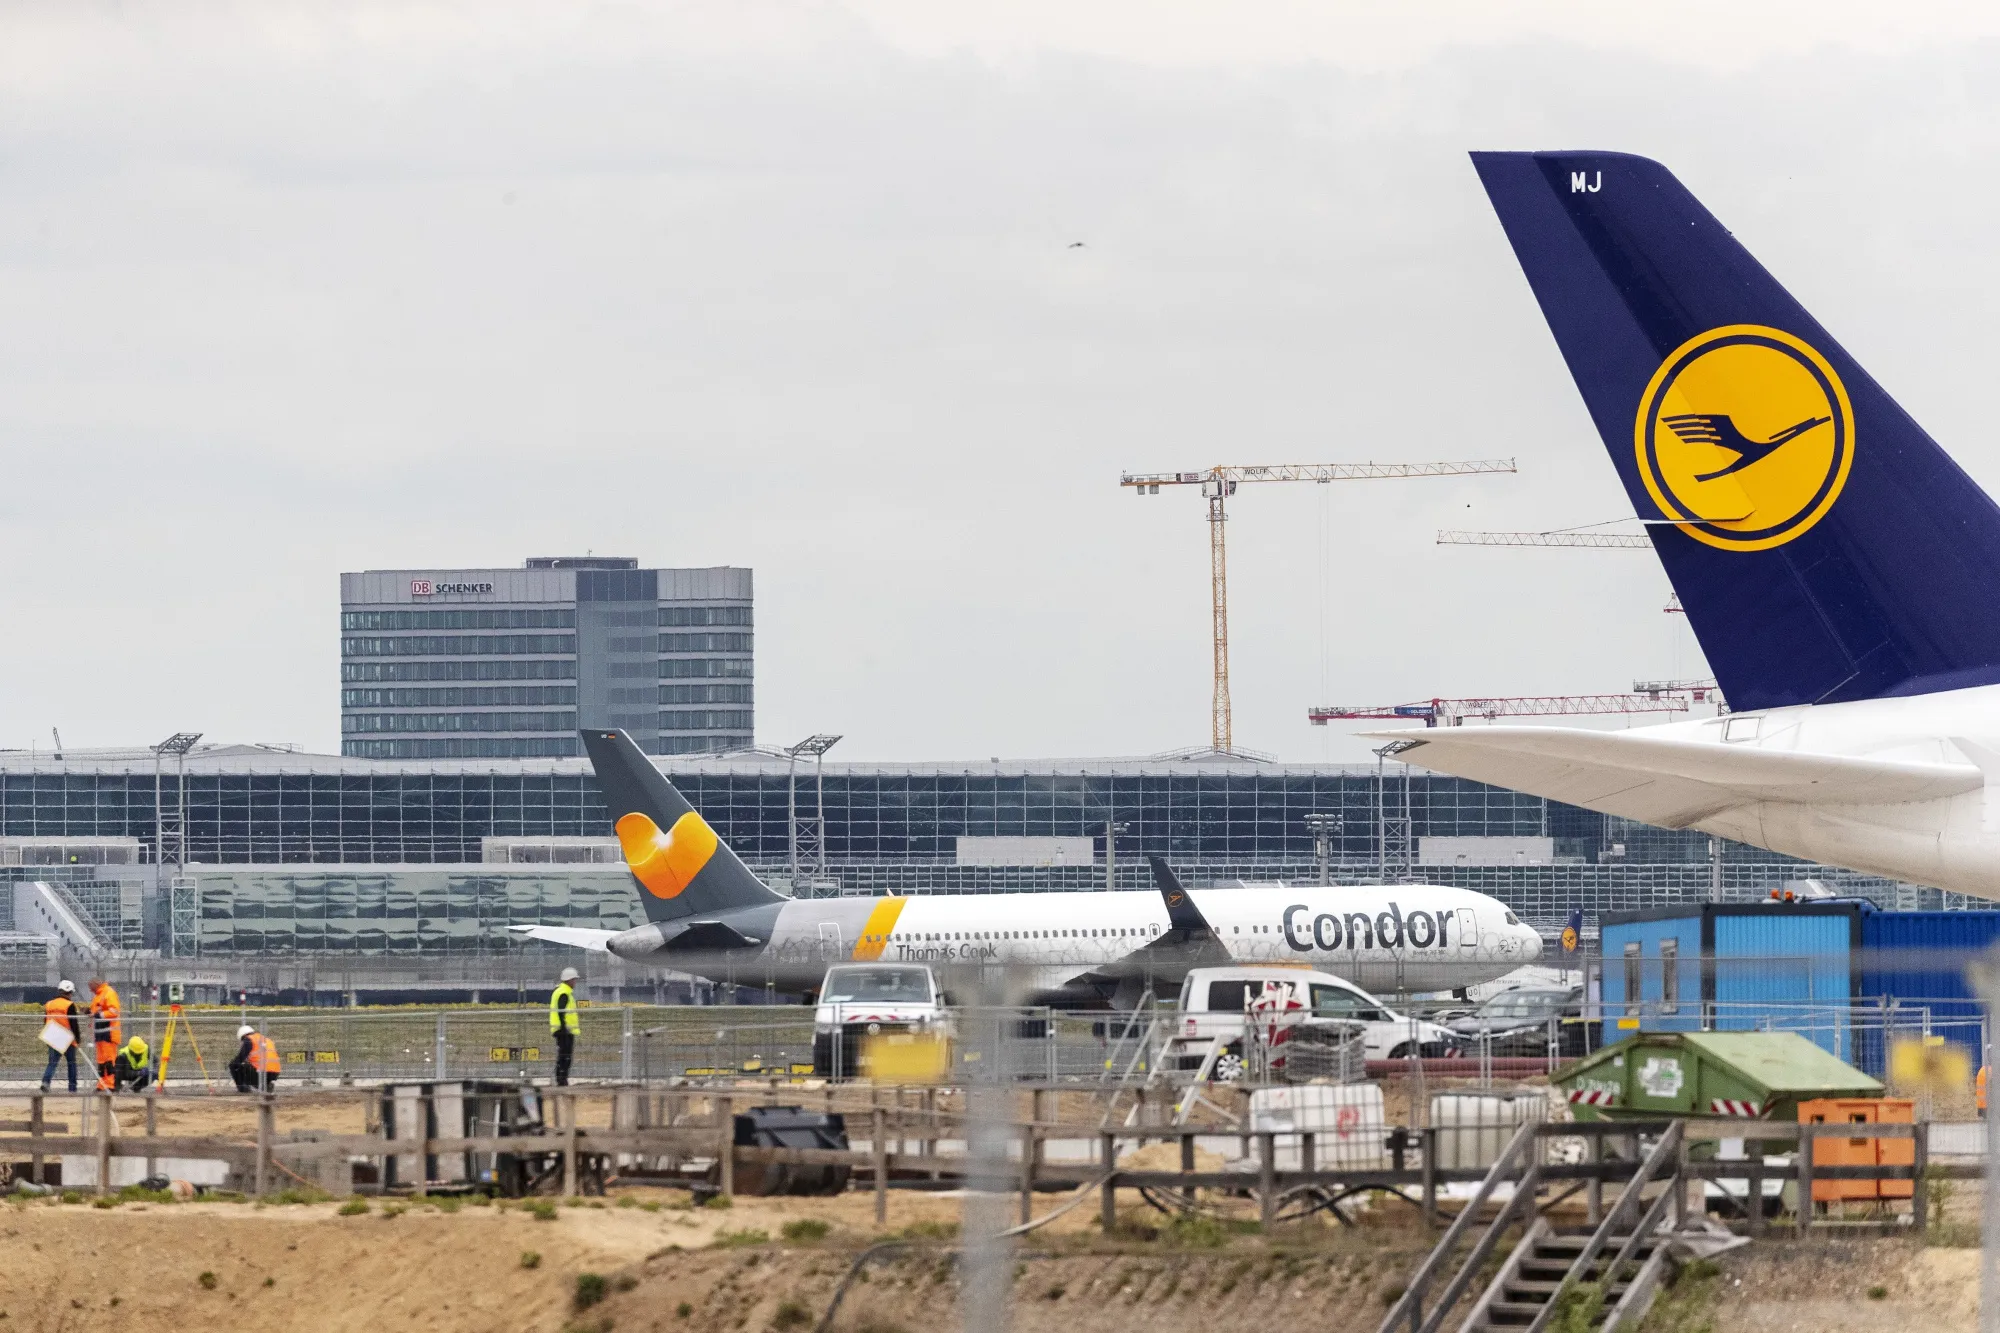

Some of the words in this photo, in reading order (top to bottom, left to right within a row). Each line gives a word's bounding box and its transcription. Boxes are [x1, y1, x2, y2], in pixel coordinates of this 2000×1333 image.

[1571, 171, 1602, 193] MJ
[413, 582, 430, 593] DB
[435, 583, 493, 593] SCHENKER
[1283, 902, 1453, 952] Condor
[896, 944, 956, 961] Thomas
[960, 942, 998, 959] Cook
